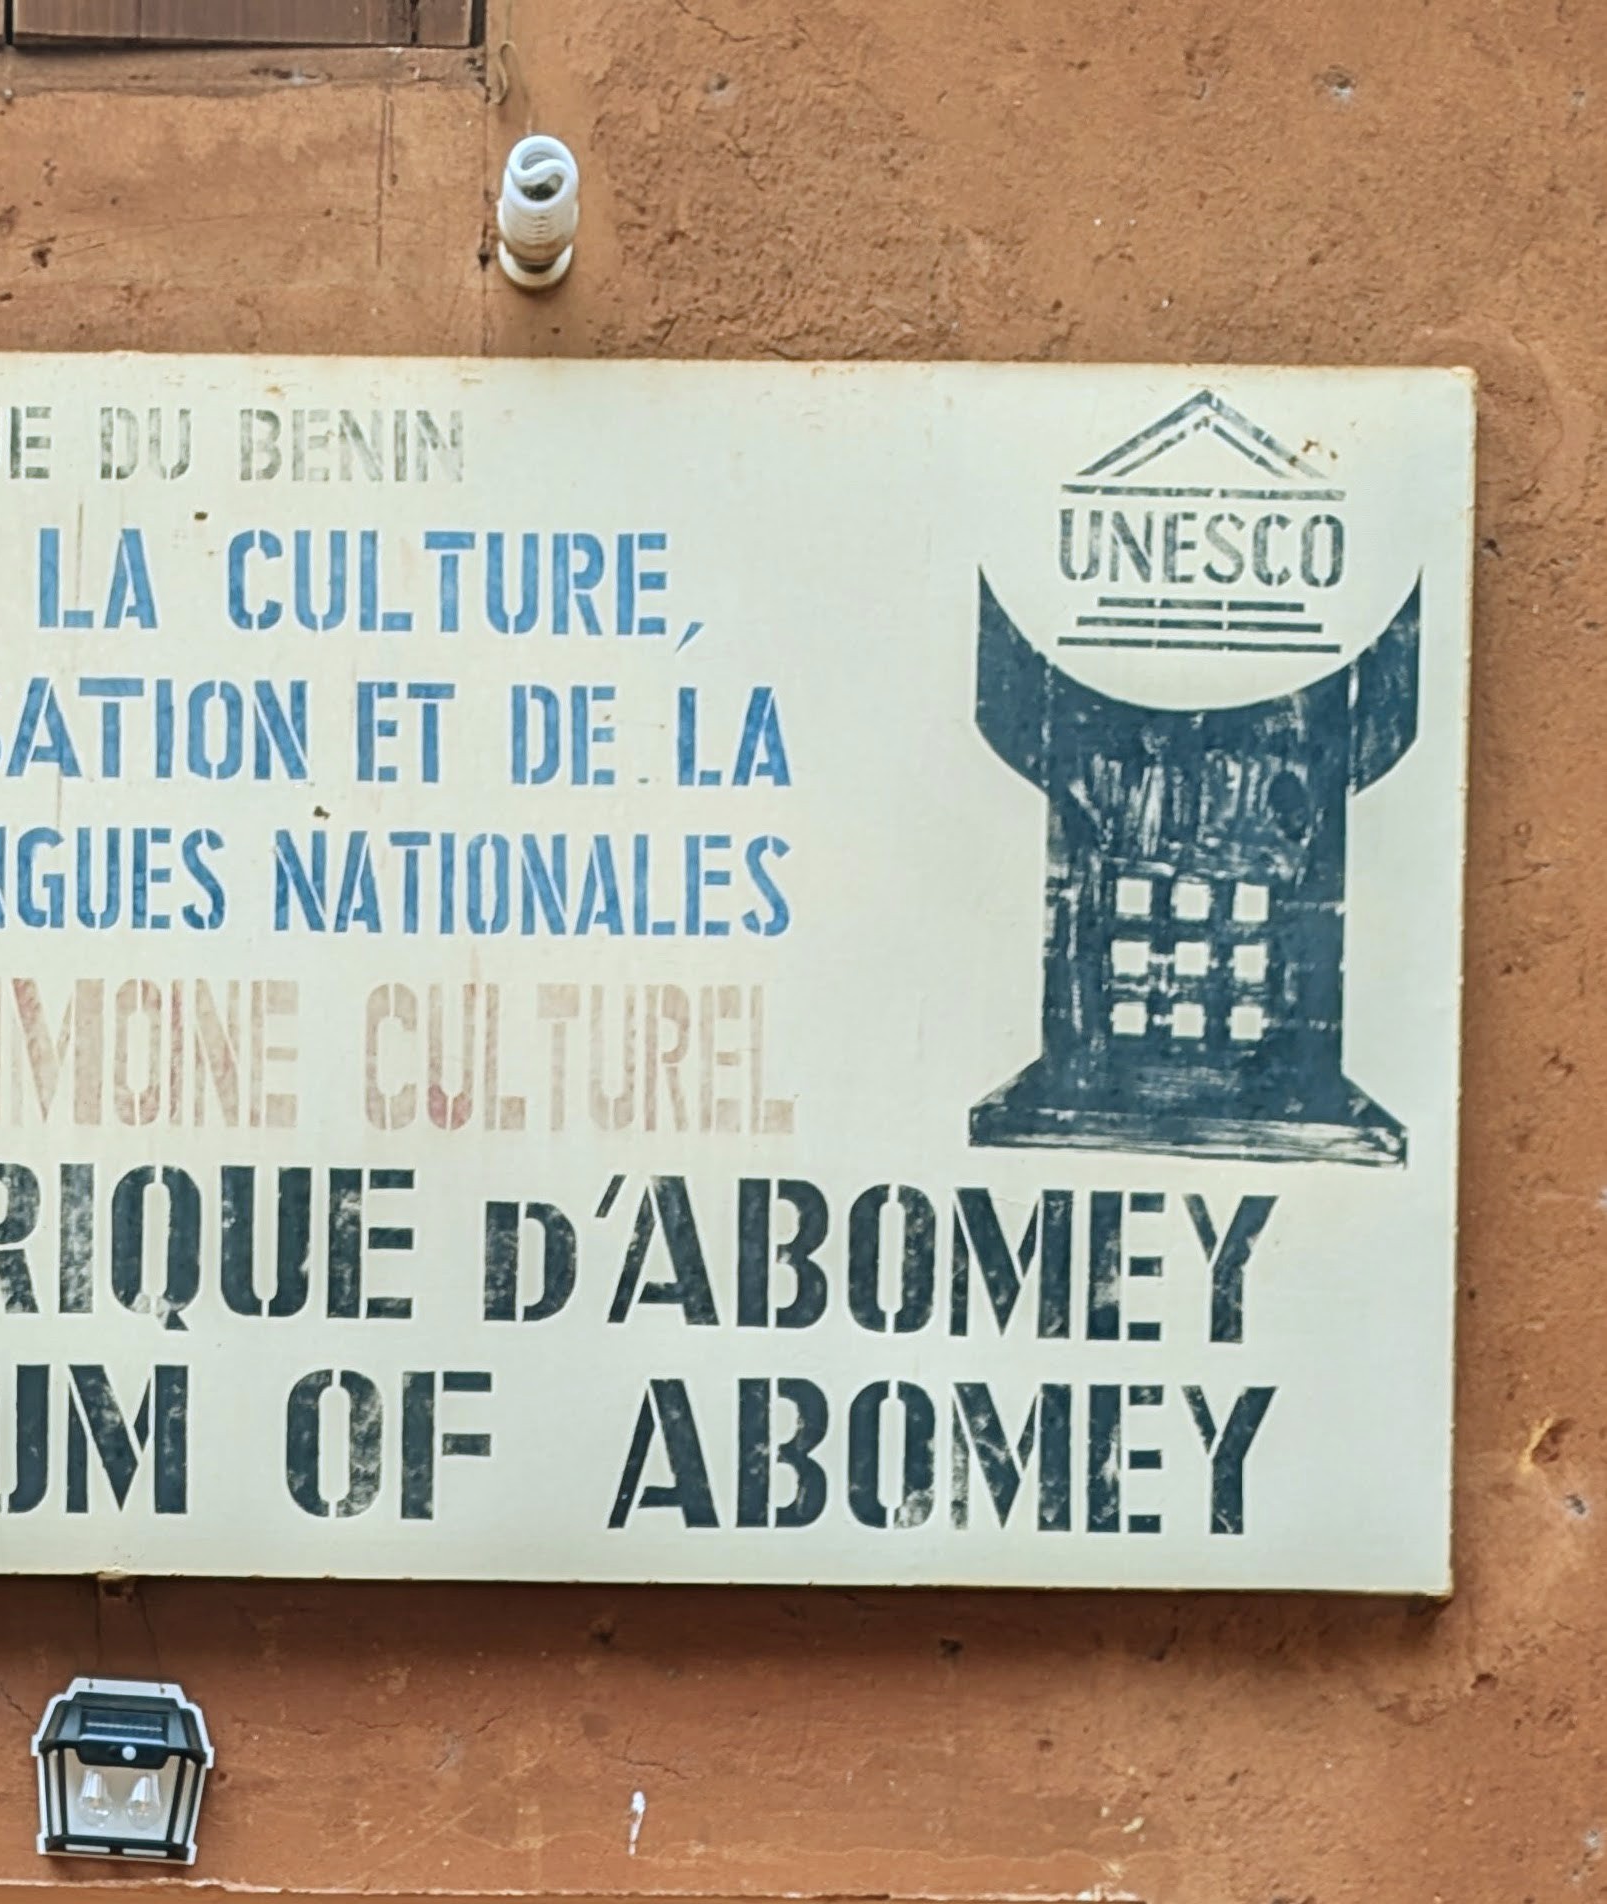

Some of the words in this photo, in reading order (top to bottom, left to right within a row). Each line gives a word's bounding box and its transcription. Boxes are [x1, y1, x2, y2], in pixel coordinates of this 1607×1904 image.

[99, 406, 192, 482] DU
[239, 408, 464, 483] BENIN
[38, 527, 159, 630] LA
[227, 529, 706, 654] CULTURE,
[1058, 507, 1347, 590] UNESCO
[355, 680, 457, 784] ET
[510, 684, 618, 787] DE
[676, 685, 793, 788] LA
[272, 828, 792, 938] NATIONALES
[364, 982, 796, 1134] CULTUREL
[482, 1173, 1281, 1345] D'ABOMEY
[284, 1368, 494, 1521] OF
[607, 1376, 1280, 1536] ABOMEY
